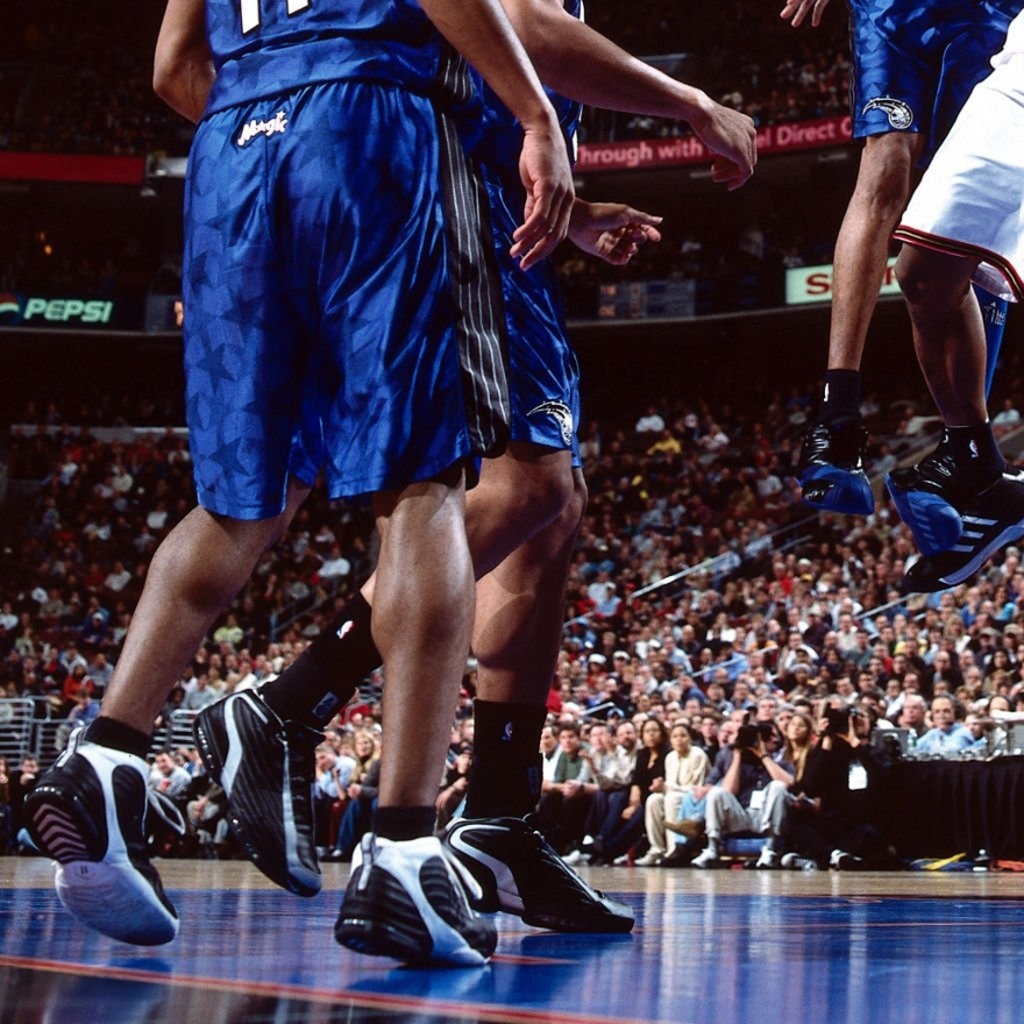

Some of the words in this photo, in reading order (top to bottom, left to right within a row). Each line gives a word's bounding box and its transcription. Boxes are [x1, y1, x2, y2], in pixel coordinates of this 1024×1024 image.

[237, 110, 288, 146] Magic
[776, 120, 836, 146] Direct
[657, 136, 704, 158] with
[23, 298, 113, 323] PEPSI
